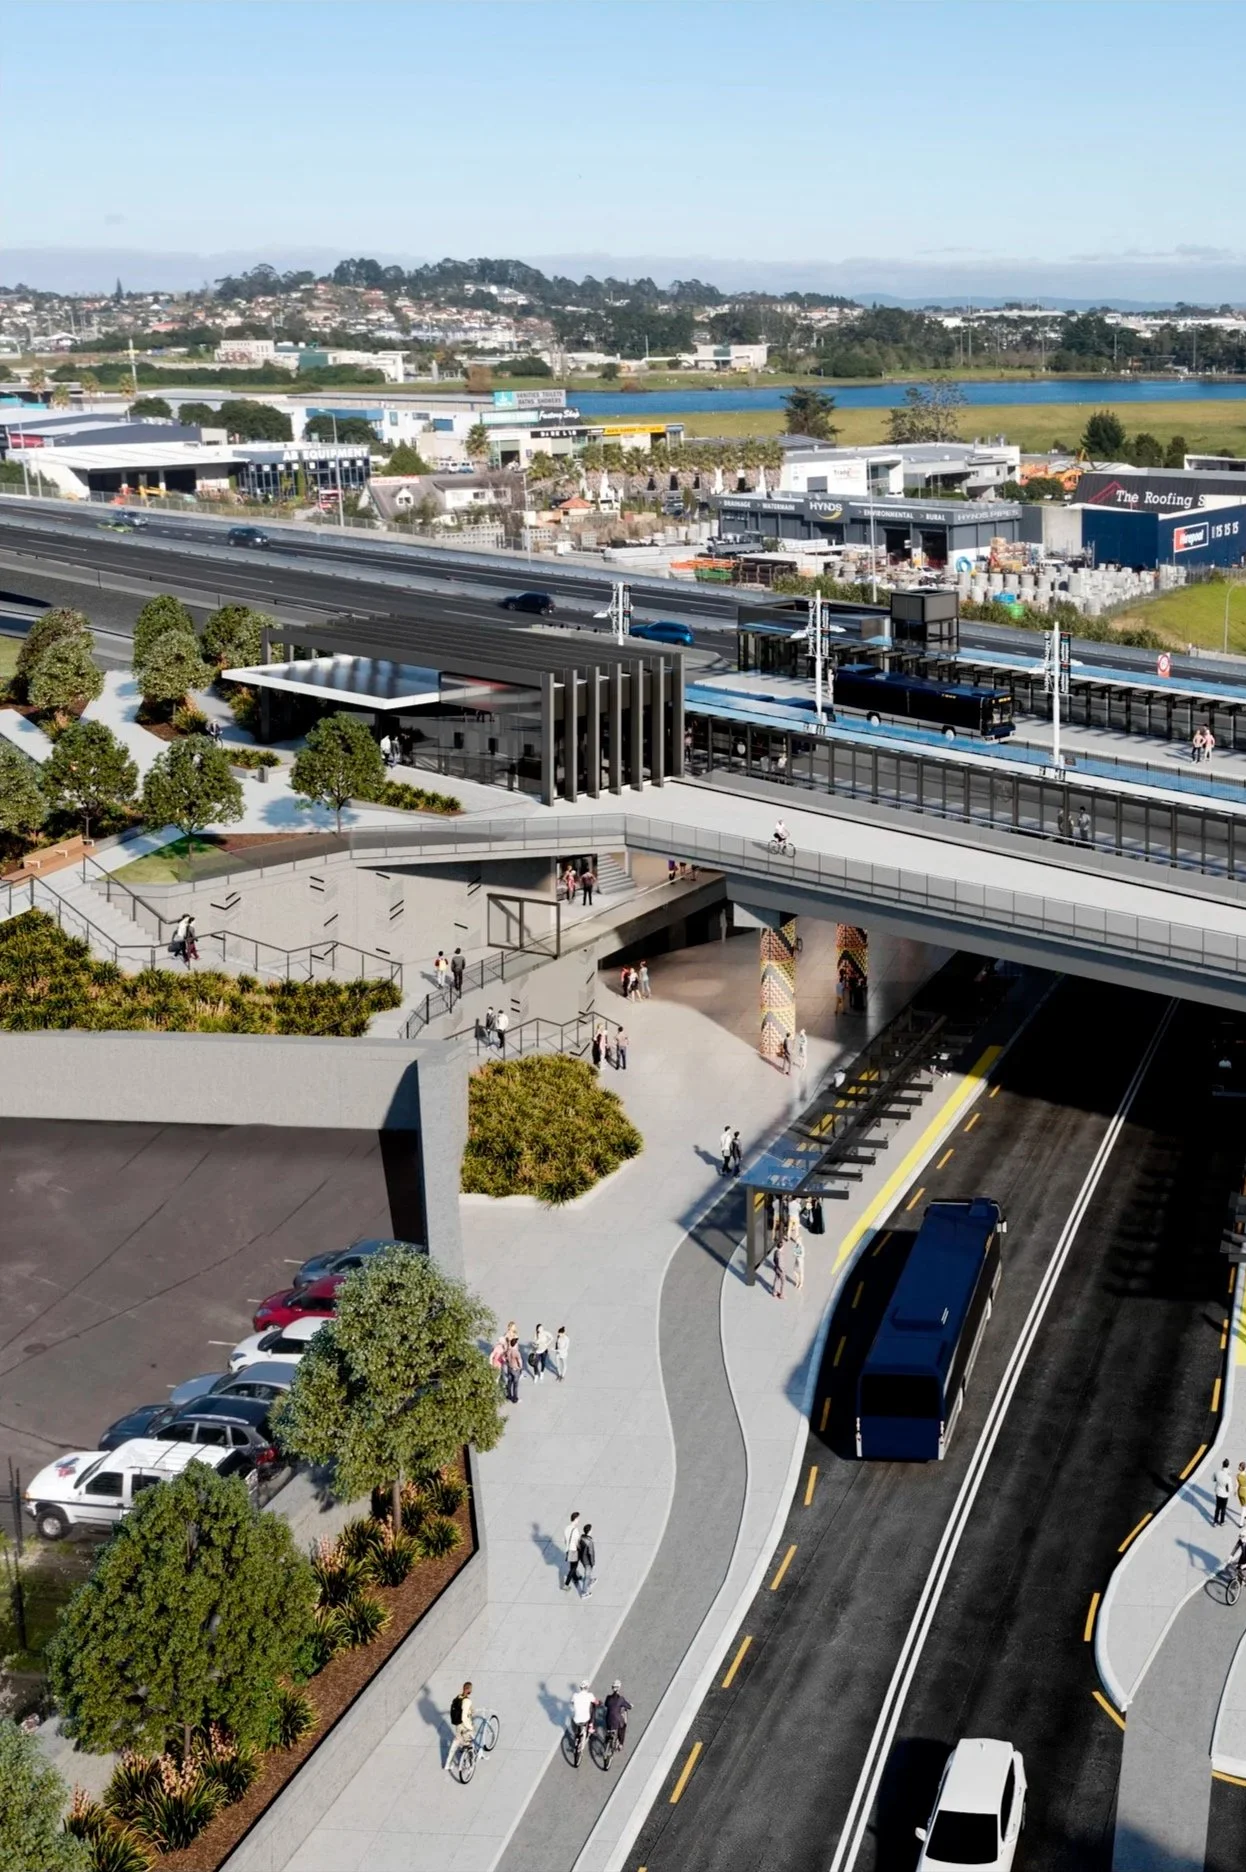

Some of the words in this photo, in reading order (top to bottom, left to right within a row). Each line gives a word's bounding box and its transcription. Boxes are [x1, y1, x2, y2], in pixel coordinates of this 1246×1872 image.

[283, 450, 299, 461] AB
[302, 447, 368, 461] EQUIPMENT
[723, 500, 751, 508] DRAINAGE
[1116, 489, 1140, 503] The
[1144, 491, 1193, 509] Roofing
[762, 502, 795, 511] WATERMAIN
[809, 501, 843, 512] HYNDS
[864, 509, 914, 519] ENVIRONMENTAL
[925, 513, 946, 521] RURAL
[957, 513, 989, 521] HYNDS
[989, 510, 1019, 519] PIPES
